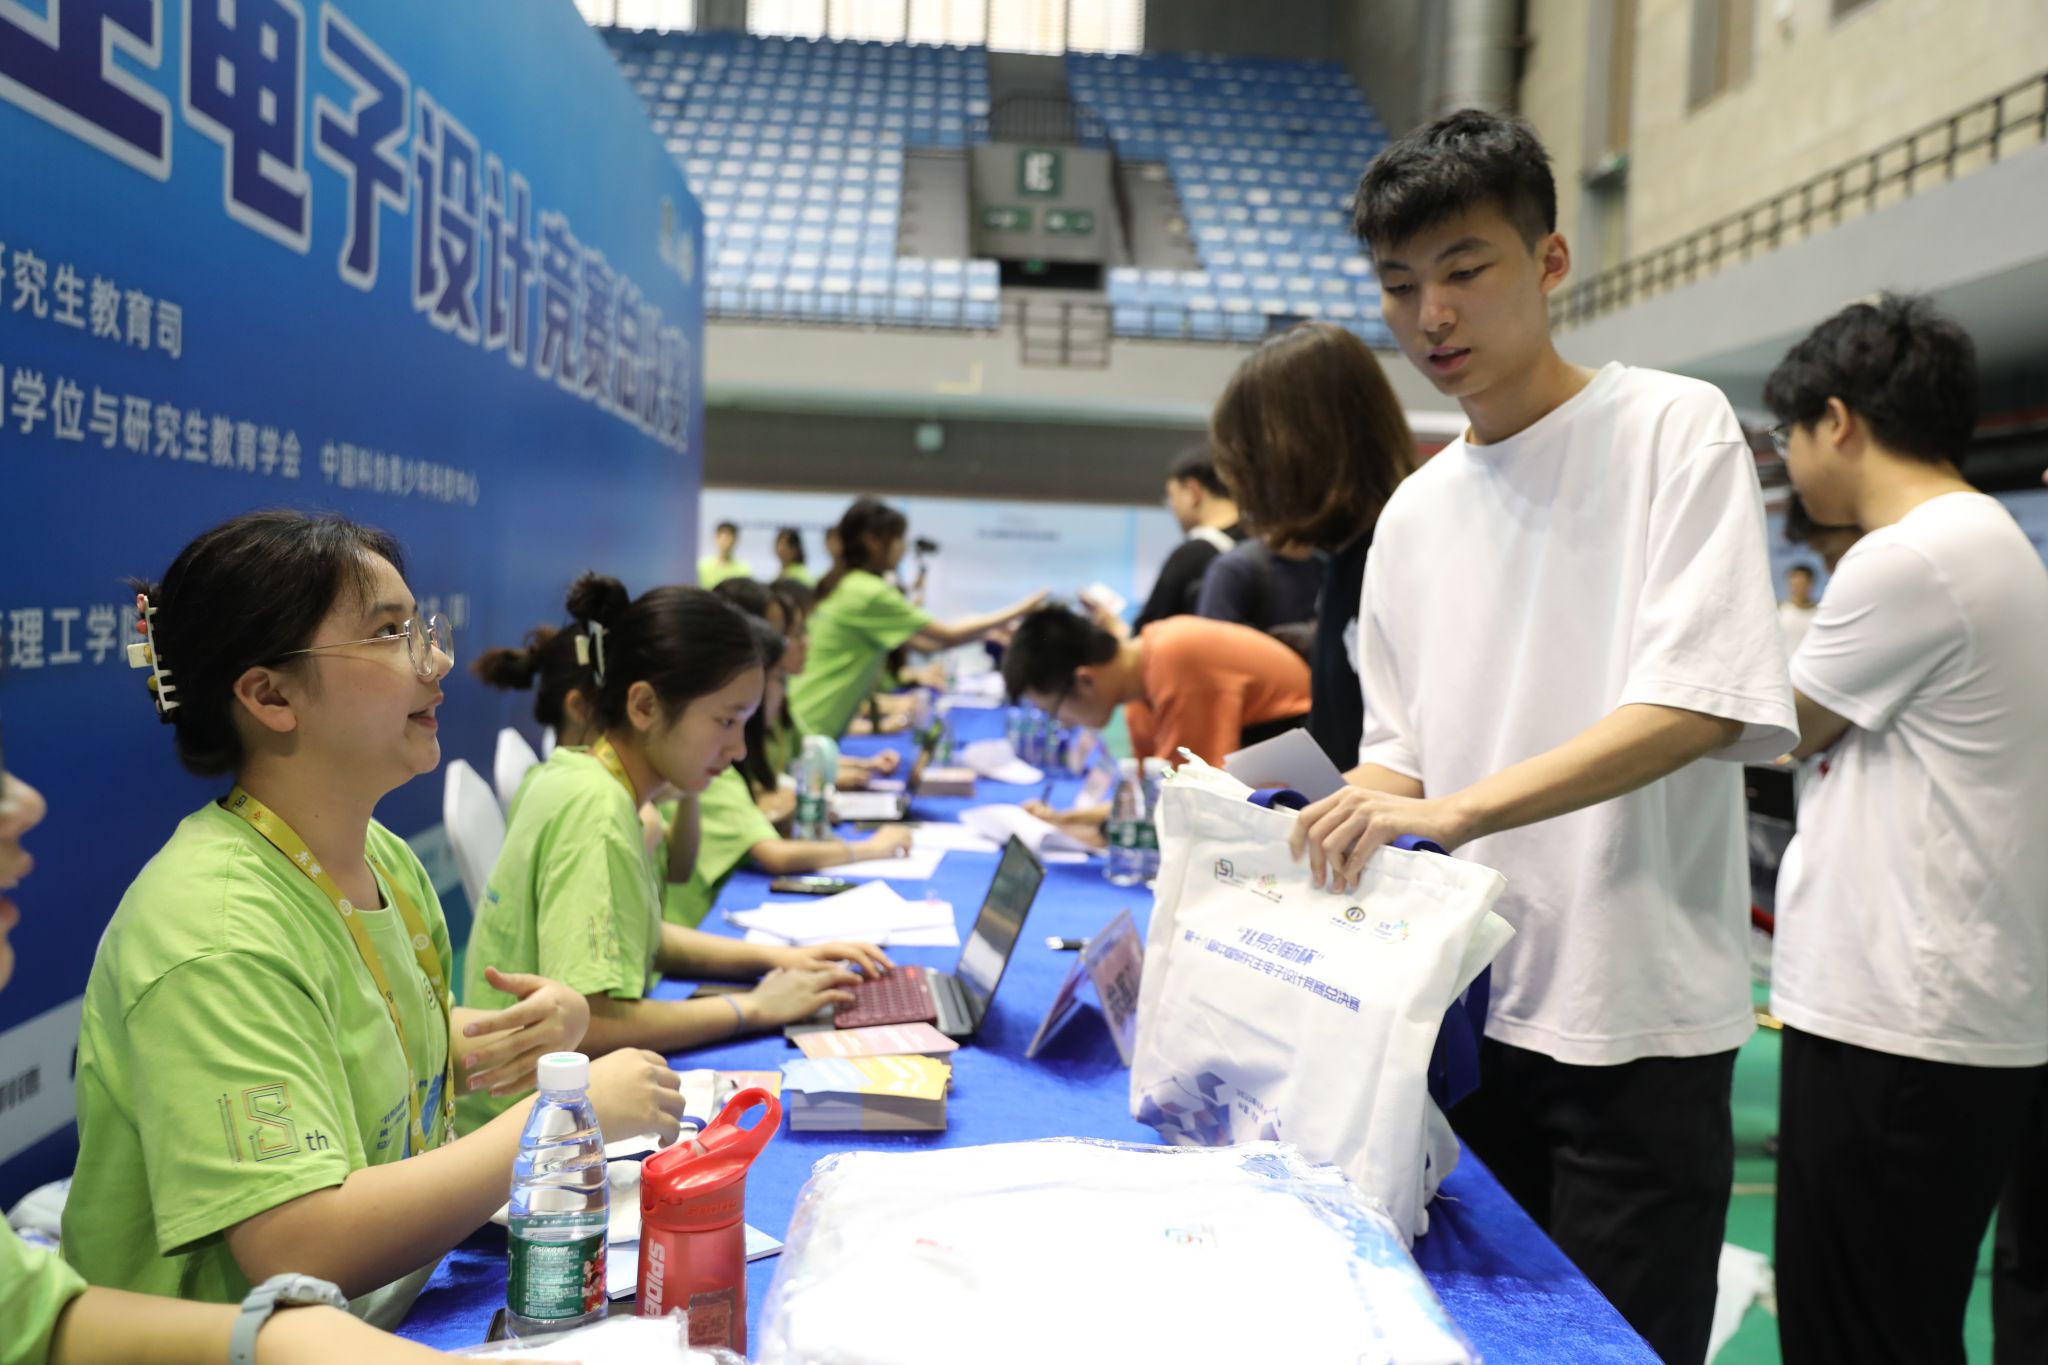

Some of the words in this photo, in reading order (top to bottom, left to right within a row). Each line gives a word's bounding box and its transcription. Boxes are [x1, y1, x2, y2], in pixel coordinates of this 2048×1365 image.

[0, 363, 303, 479] 学位与研究生教育学会
